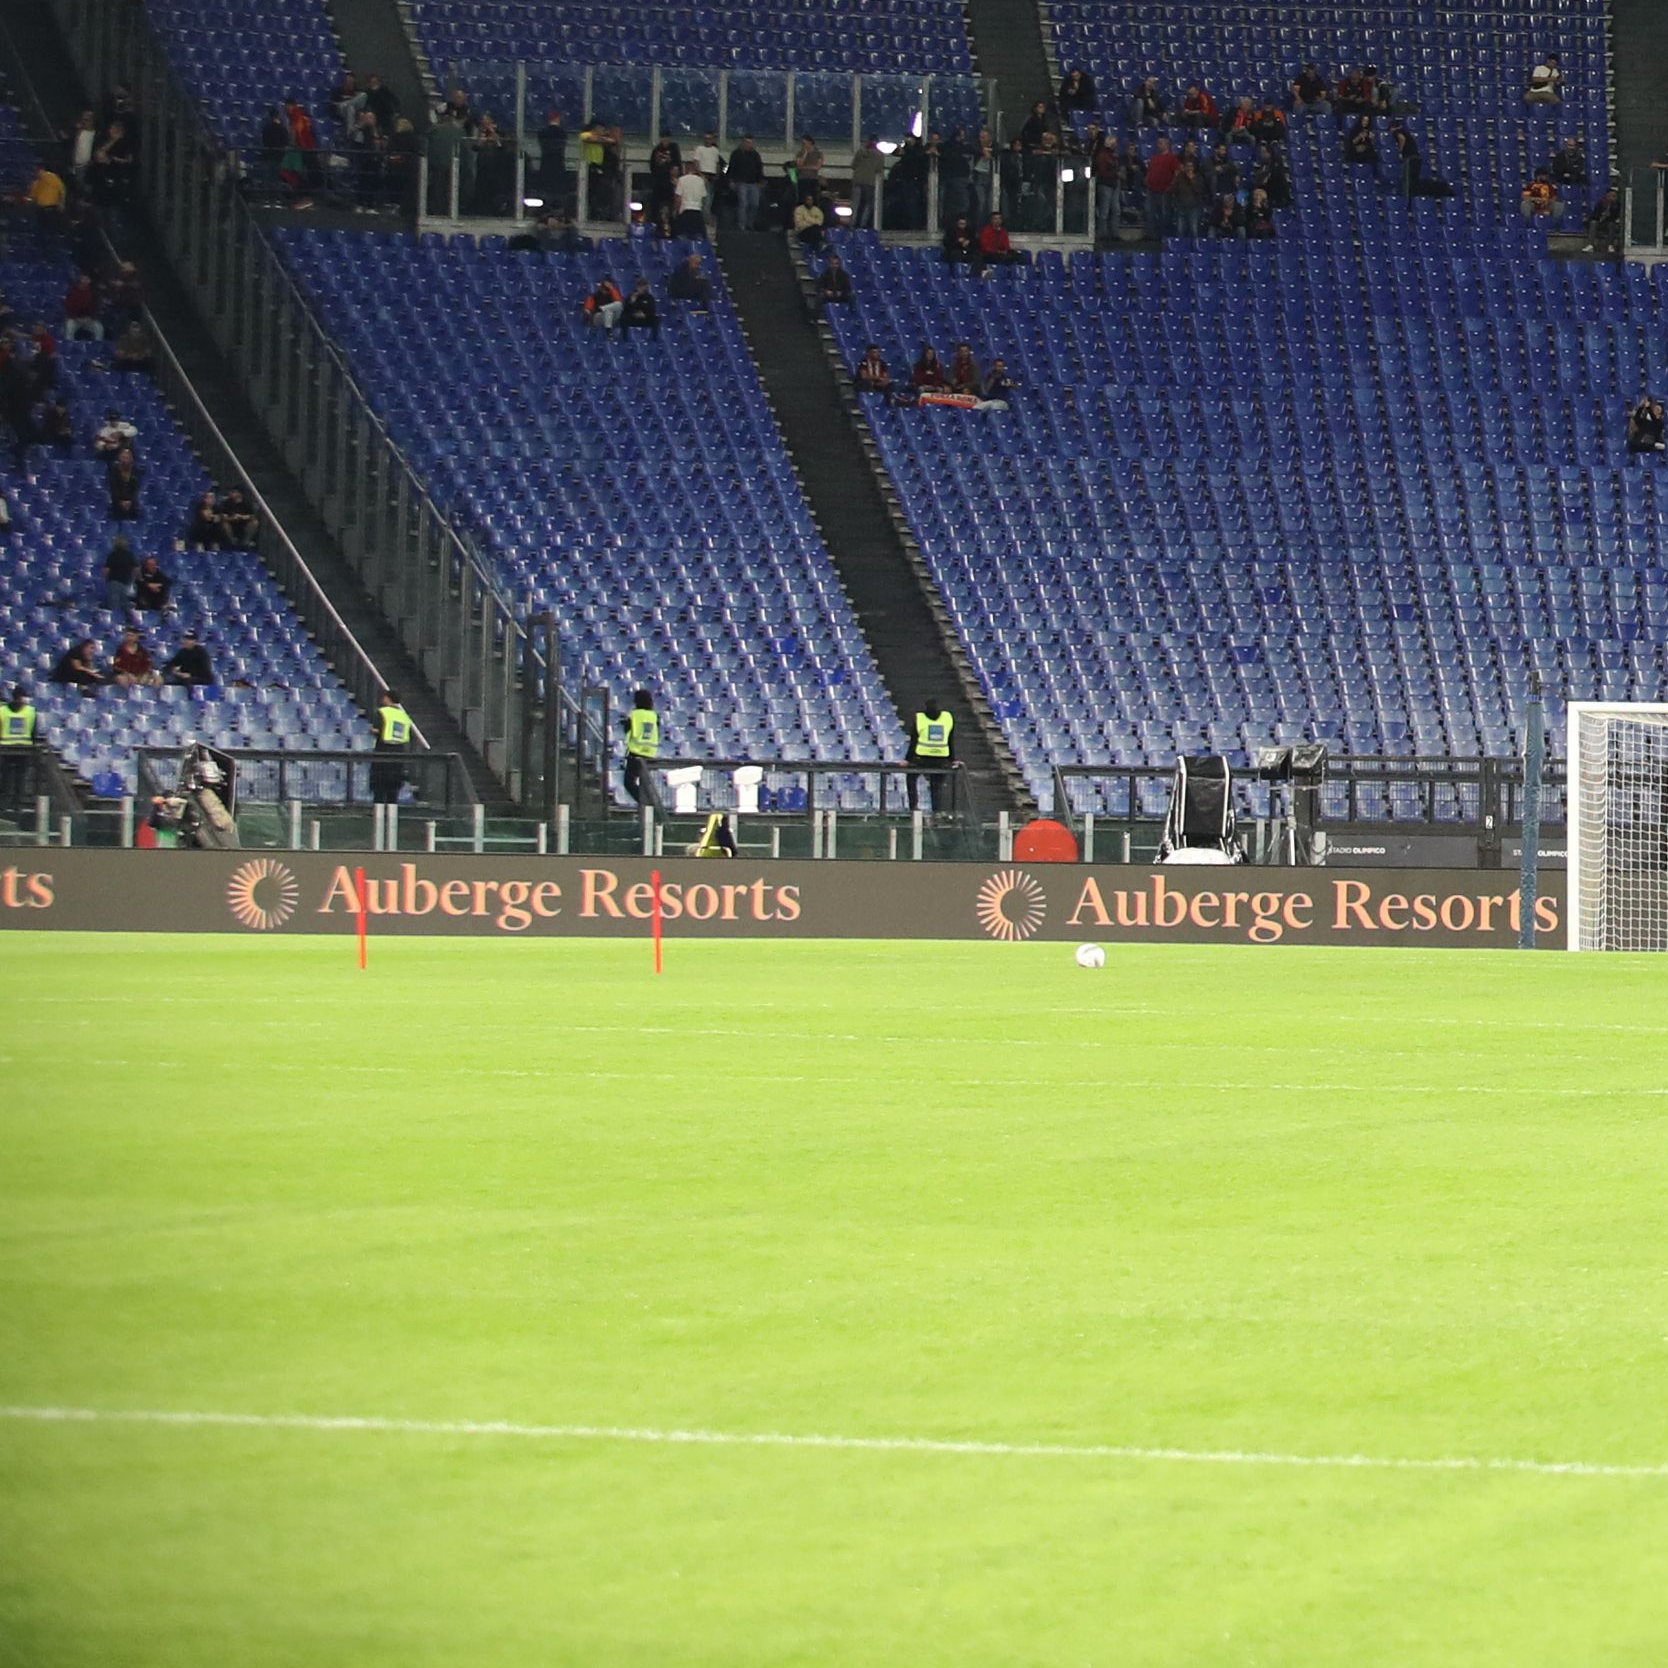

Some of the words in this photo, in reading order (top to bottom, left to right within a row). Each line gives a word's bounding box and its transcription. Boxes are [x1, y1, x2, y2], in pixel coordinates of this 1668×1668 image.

[317, 863, 563, 931] Auberge
[578, 869, 801, 921] Resorts
[1066, 874, 1313, 942] Auberge
[1331, 880, 1559, 932] Resorts
